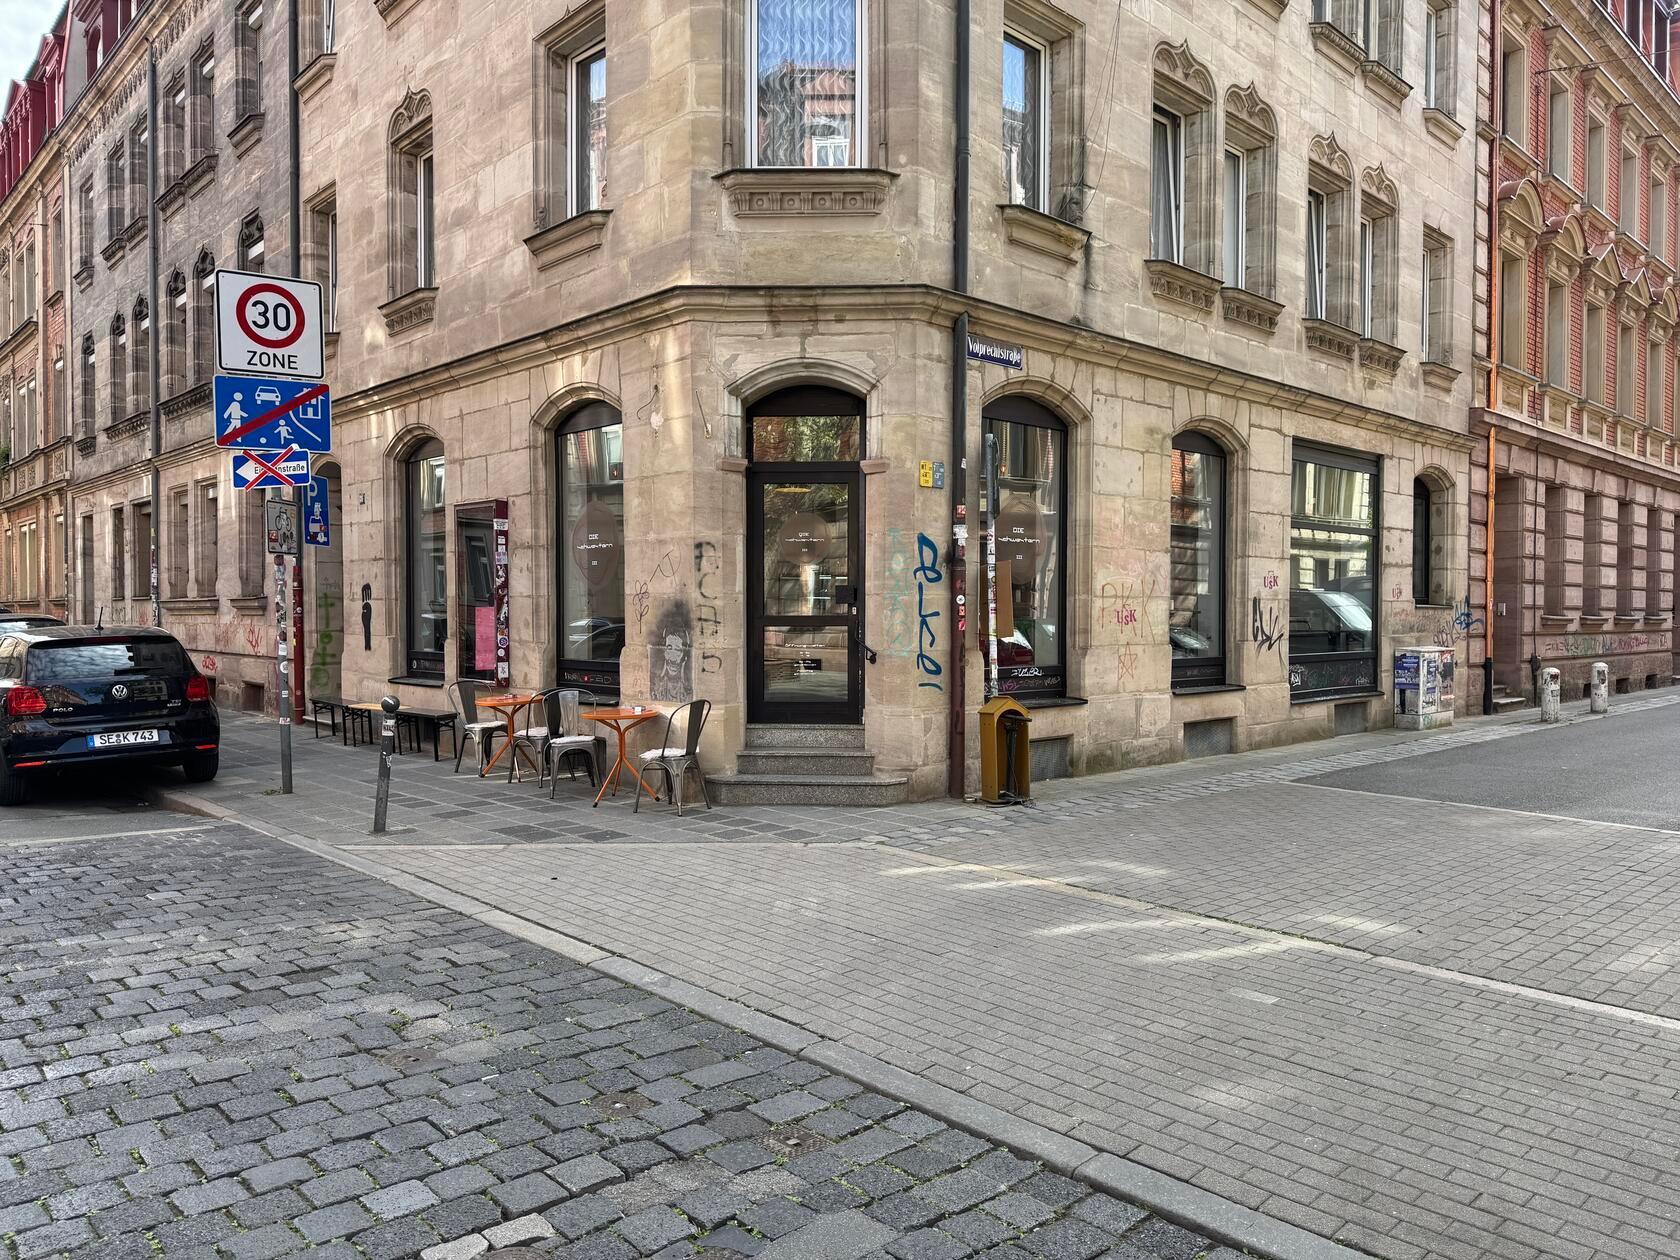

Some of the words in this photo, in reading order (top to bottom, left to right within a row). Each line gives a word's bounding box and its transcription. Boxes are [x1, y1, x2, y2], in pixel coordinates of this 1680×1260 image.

[251, 300, 291, 331] 30
[246, 350, 299, 370] ZONE
[967, 336, 1021, 364] Volprechtstraße
[99, 734, 115, 745] SE
[122, 732, 131, 743] K
[132, 730, 154, 742] 743
